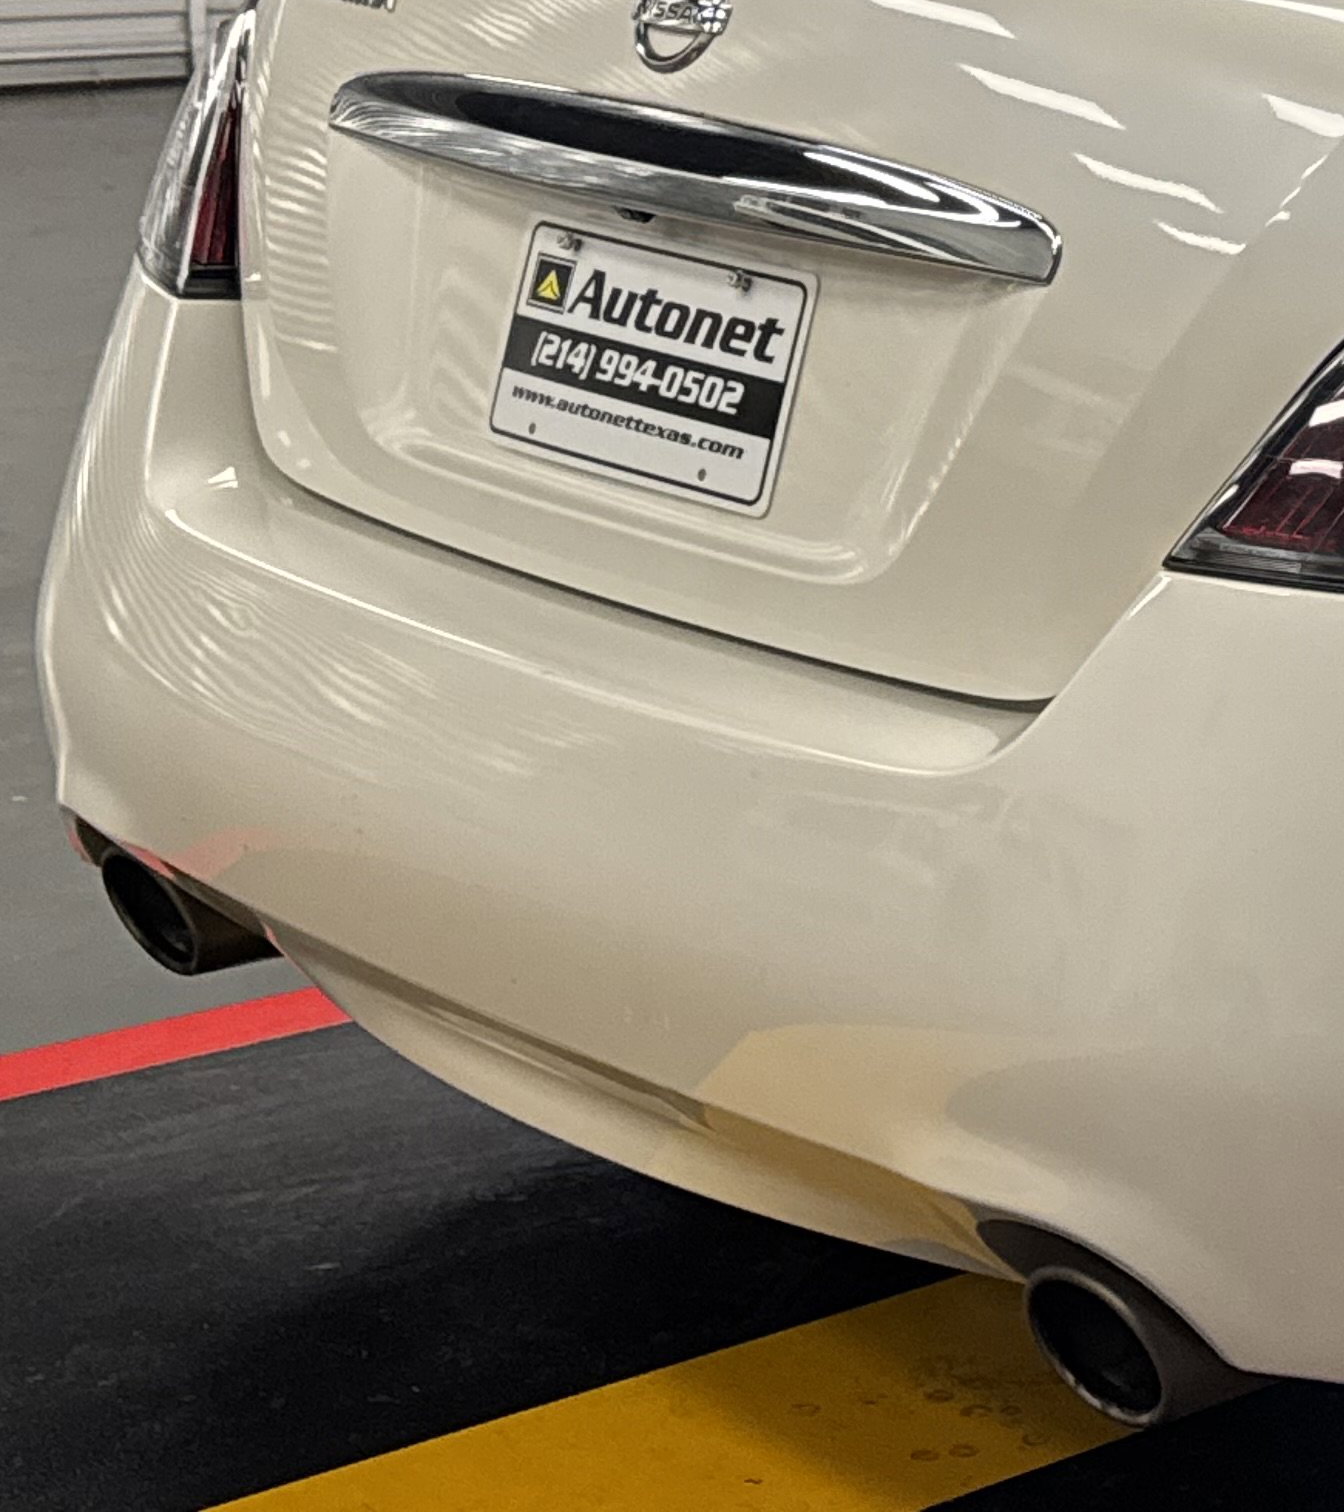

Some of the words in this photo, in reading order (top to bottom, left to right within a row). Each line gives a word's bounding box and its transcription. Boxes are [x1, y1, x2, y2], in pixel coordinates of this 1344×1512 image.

[568, 269, 785, 364] Autonet
[531, 331, 597, 381] (214)
[595, 349, 745, 415] 994-0502
[511, 384, 745, 460] www.autonettexas.com
